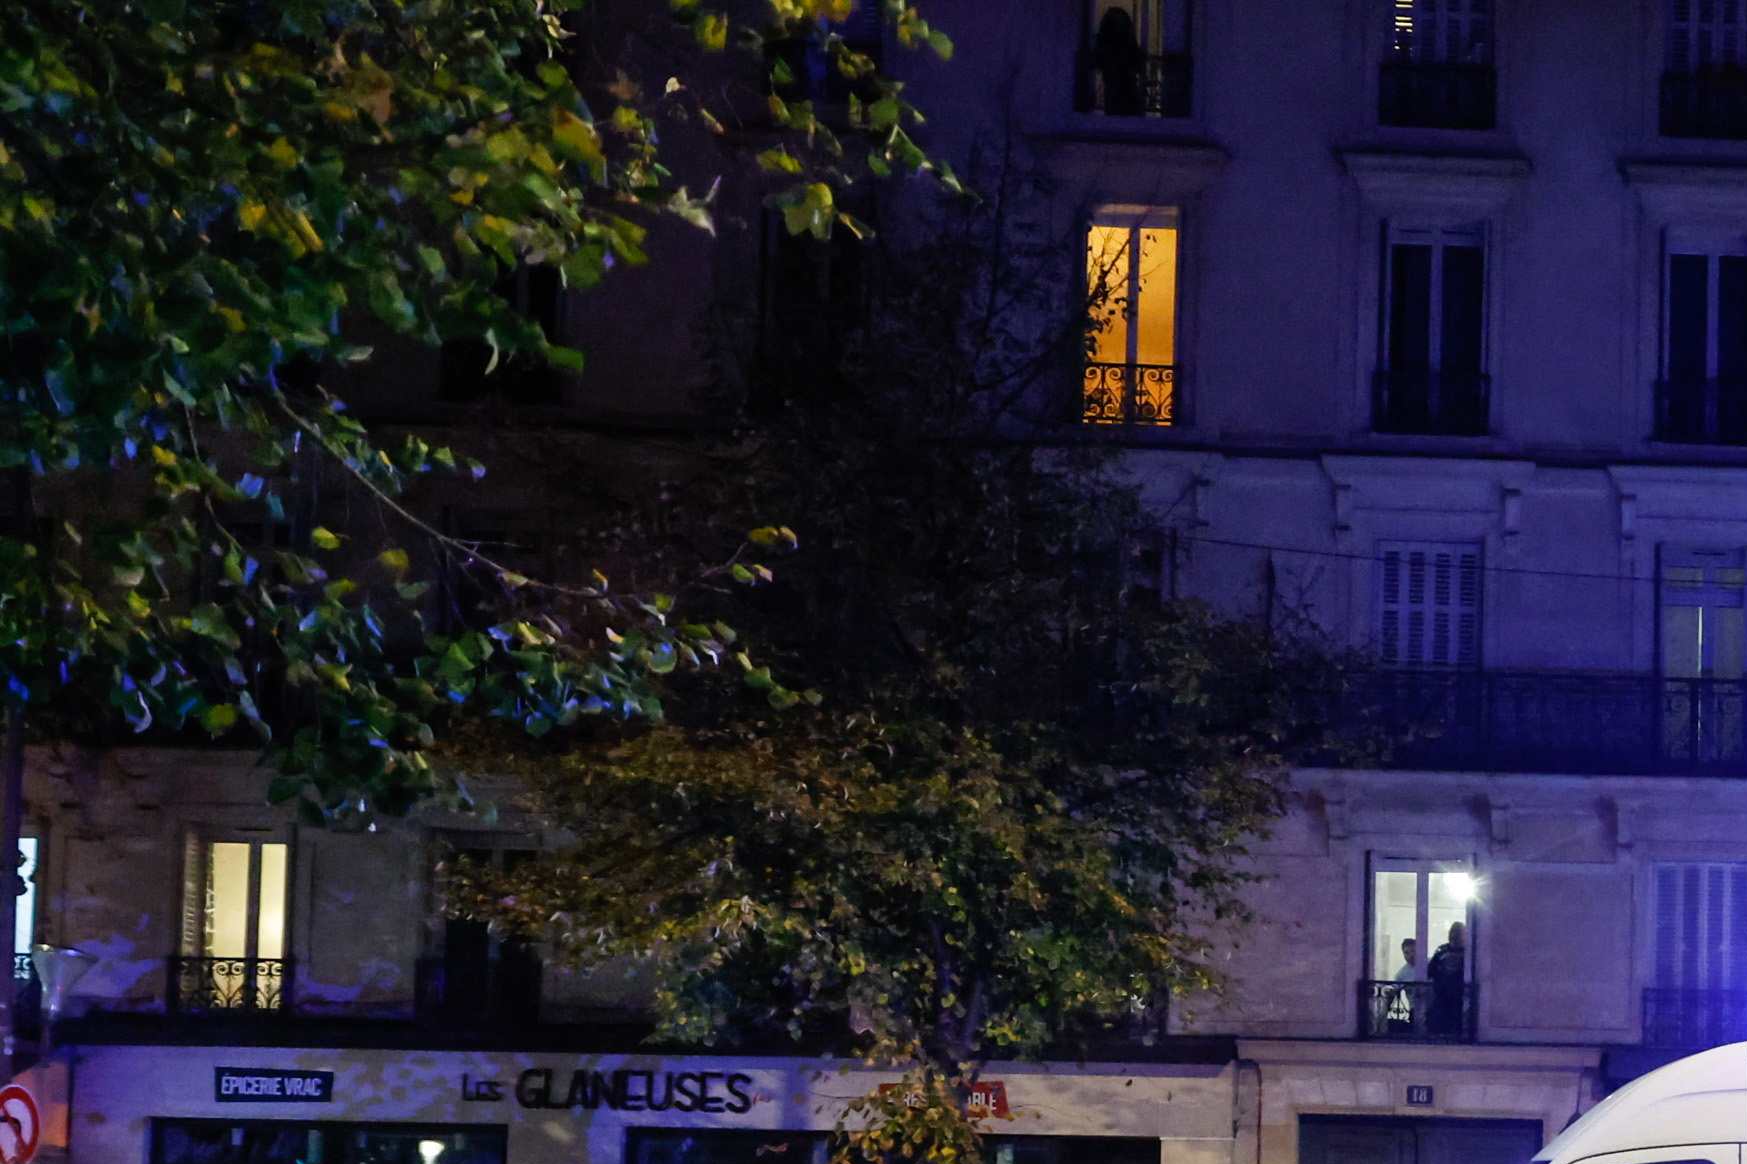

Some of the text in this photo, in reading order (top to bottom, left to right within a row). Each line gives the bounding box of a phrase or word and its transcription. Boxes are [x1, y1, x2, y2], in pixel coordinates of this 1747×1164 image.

[221, 1072, 322, 1097] ÉPICERIE VRAC
[515, 1068, 752, 1114] GLANEUSES
